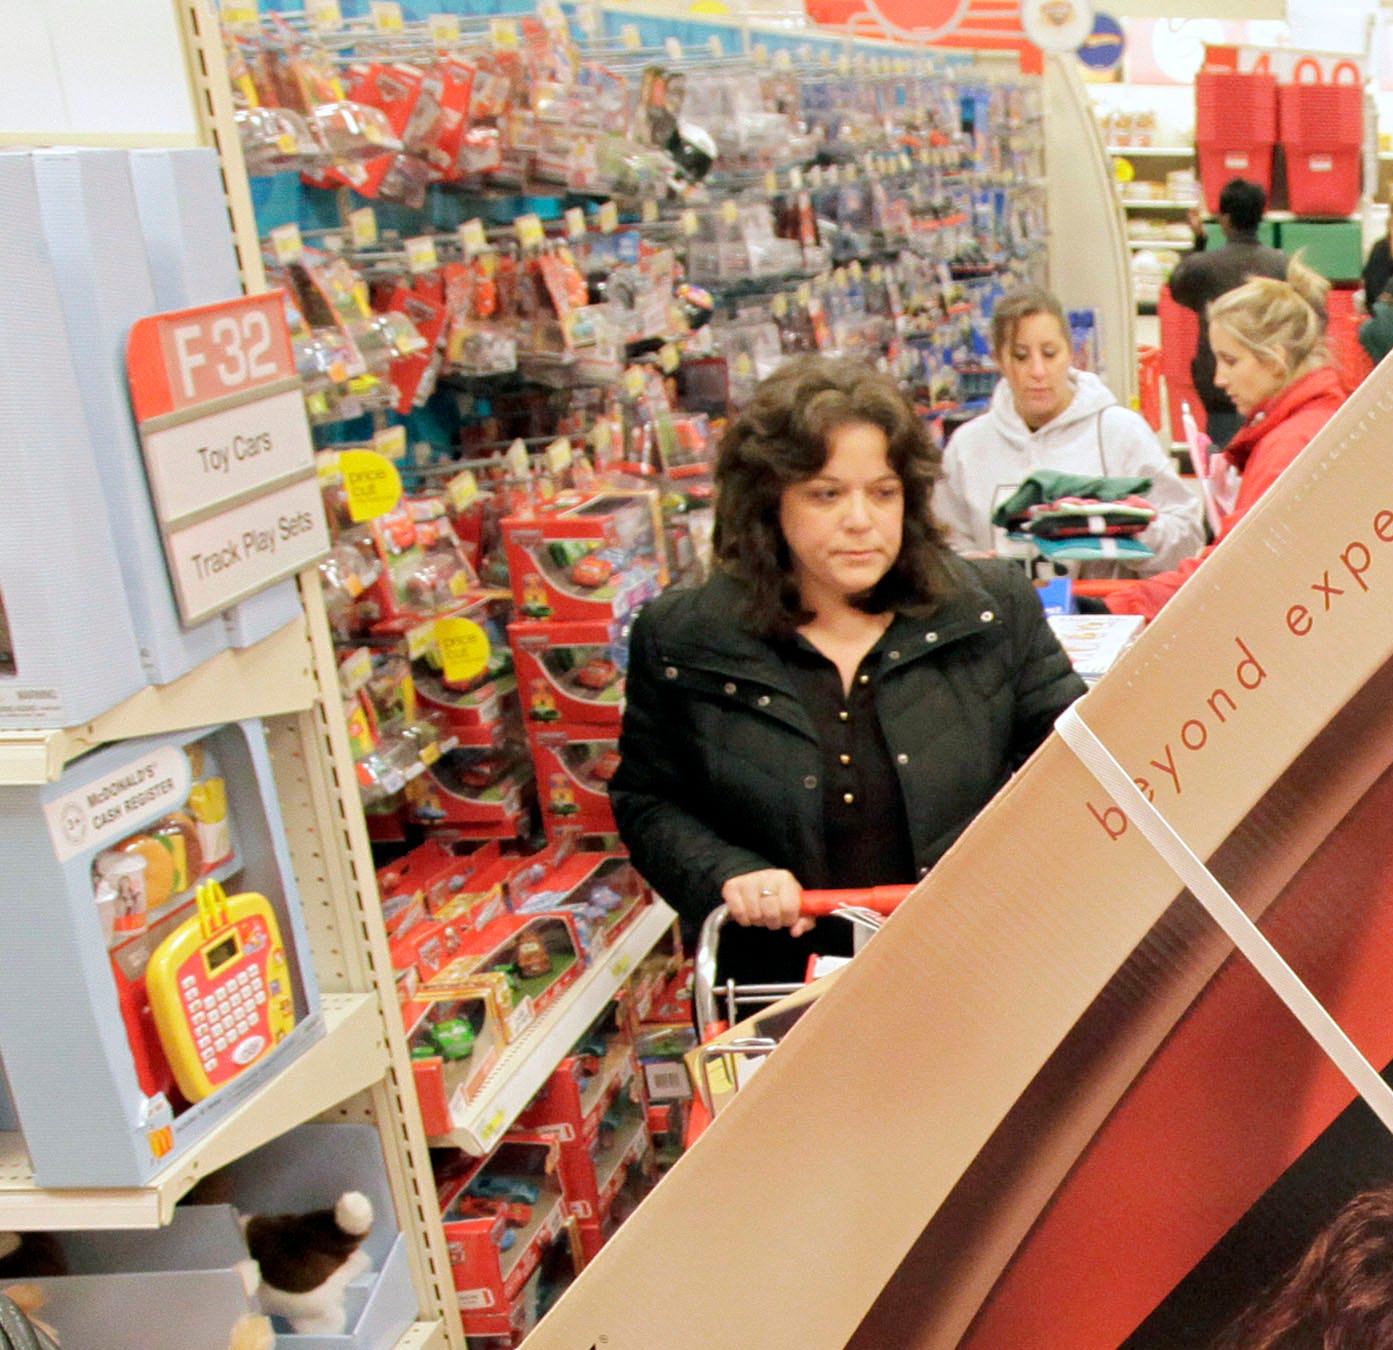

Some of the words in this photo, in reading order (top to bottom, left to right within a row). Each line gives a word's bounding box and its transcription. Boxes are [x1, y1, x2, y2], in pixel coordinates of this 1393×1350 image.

[196, 446, 230, 473] Toy
[232, 431, 273, 461] Cars
[191, 541, 242, 580] Track
[241, 528, 277, 557] Play
[278, 511, 314, 542] Sets
[91, 805, 122, 830] CASH
